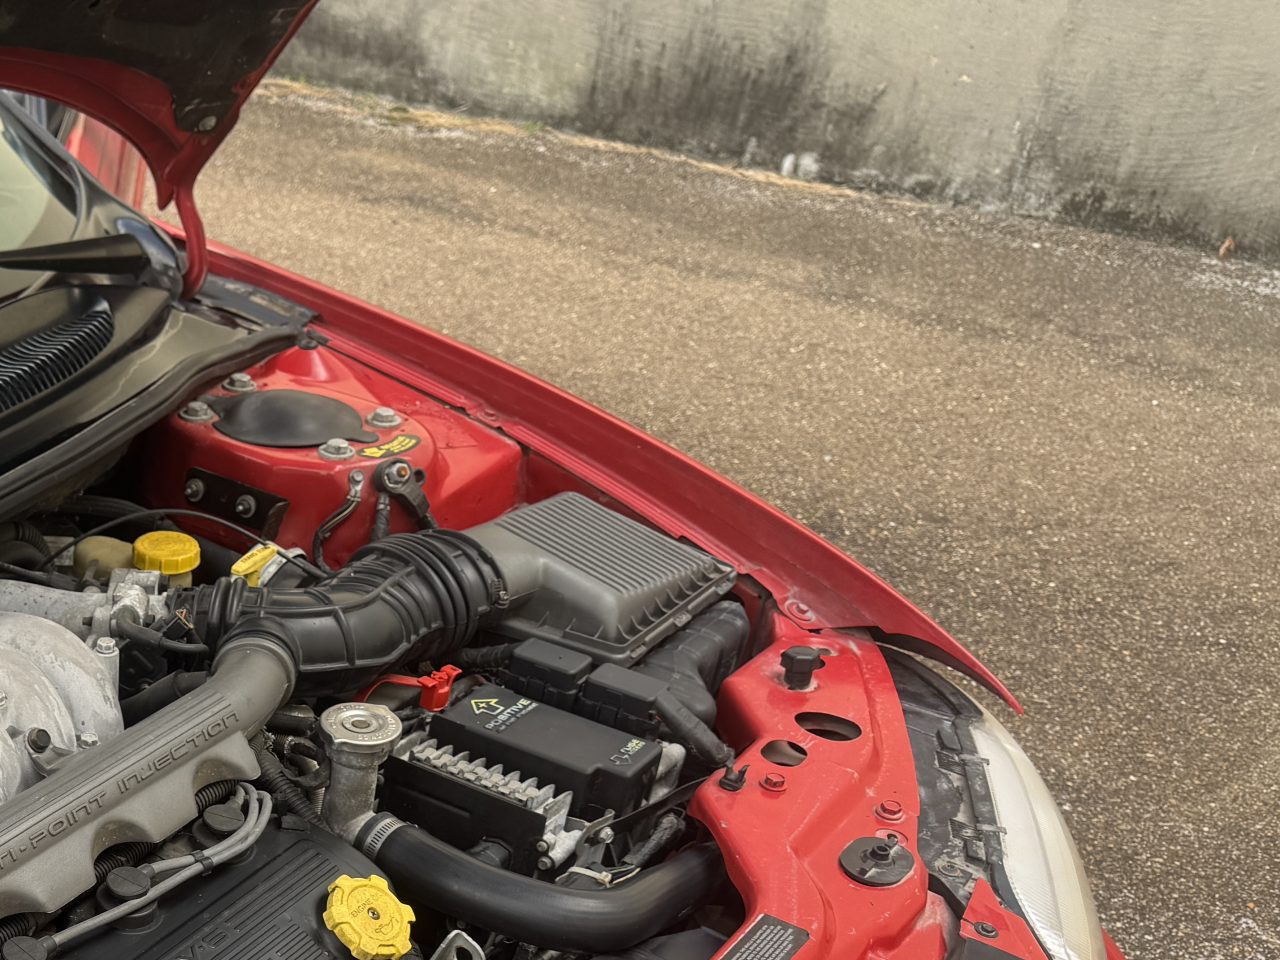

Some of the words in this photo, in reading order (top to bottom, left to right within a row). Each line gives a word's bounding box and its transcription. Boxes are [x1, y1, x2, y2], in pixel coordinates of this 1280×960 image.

[484, 698, 531, 730] POSITIVE
[116, 710, 240, 794] INJECTION
[350, 898, 374, 918] ENGINE
